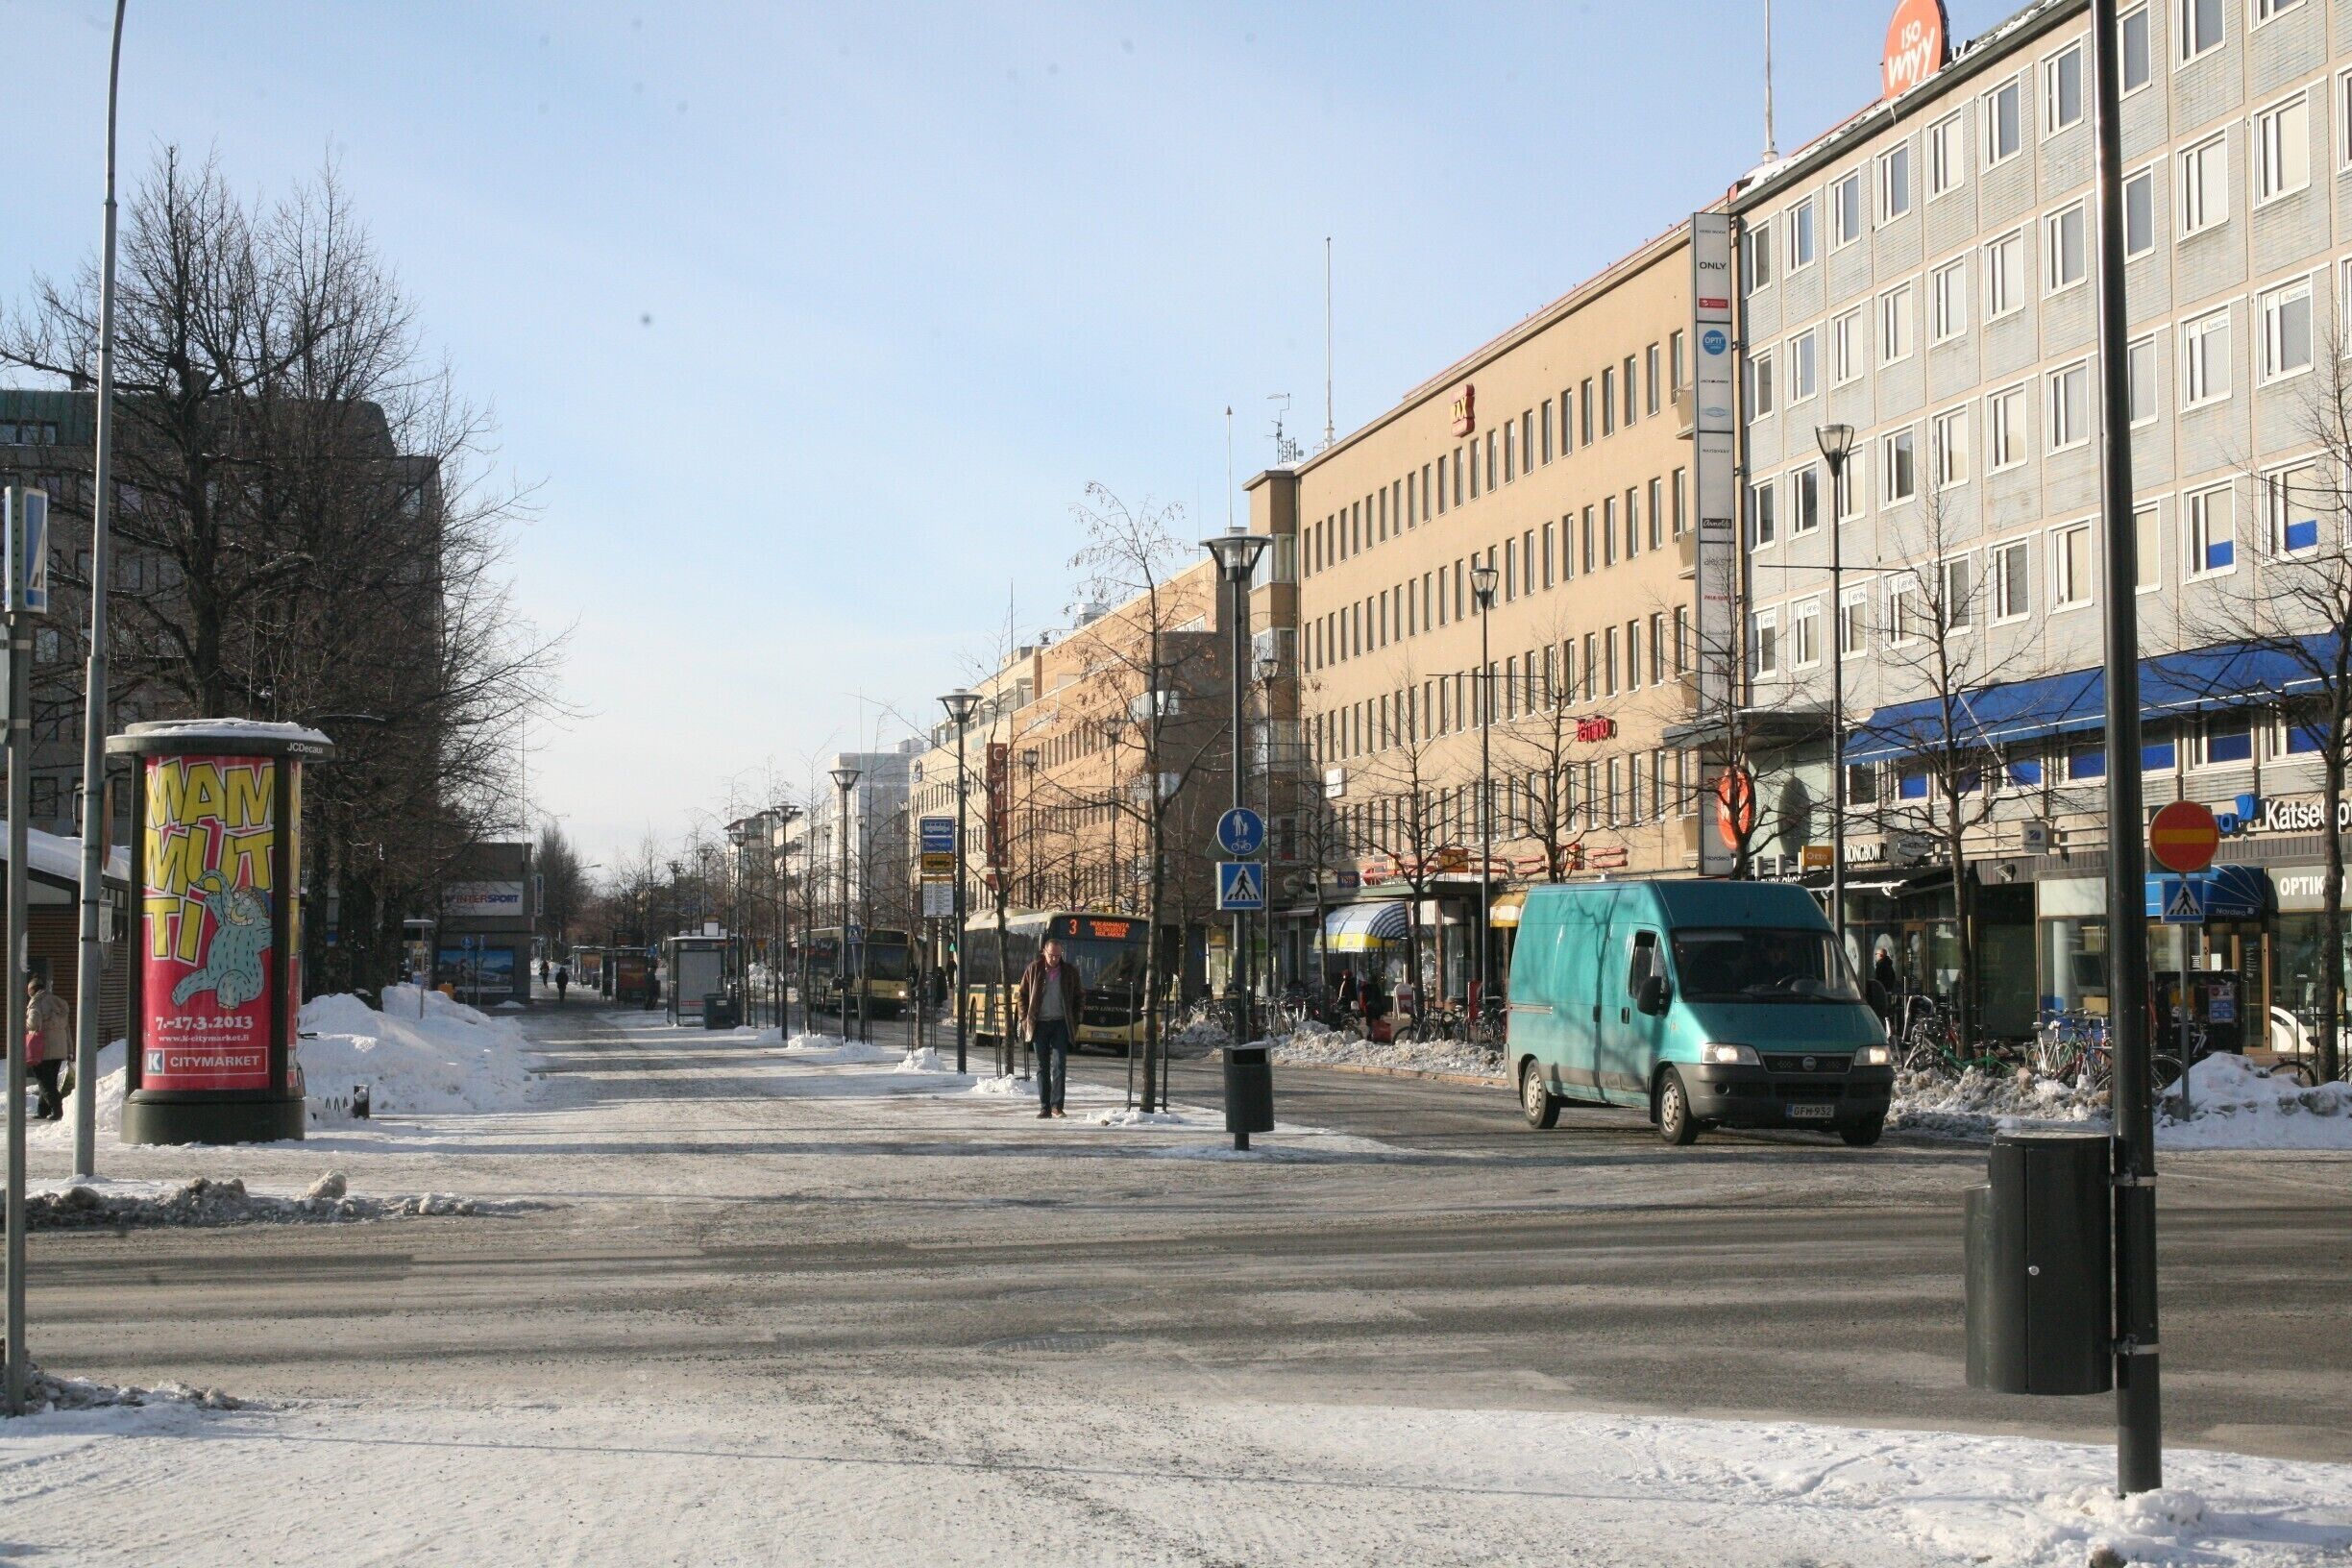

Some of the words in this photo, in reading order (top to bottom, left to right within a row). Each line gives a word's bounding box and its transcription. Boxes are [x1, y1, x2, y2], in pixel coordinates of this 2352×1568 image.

[1901, 20, 1922, 50] ISO
[1700, 261, 1727, 270] ONLY
[287, 742, 324, 754] JCDecaux
[144, 824, 275, 897] MUT
[1844, 843, 1881, 863] RONGBOW
[455, 894, 519, 903] INTERSPORT
[2216, 906, 2247, 918] Nordea
[144, 894, 205, 964] TI
[1068, 919, 1078, 935] 3
[155, 1016, 255, 1031] 7.-17.3.2013
[159, 1035, 250, 1043] www.k-citymarket.fi
[147, 1052, 161, 1071] K
[170, 1055, 260, 1068] CITYMARKET
